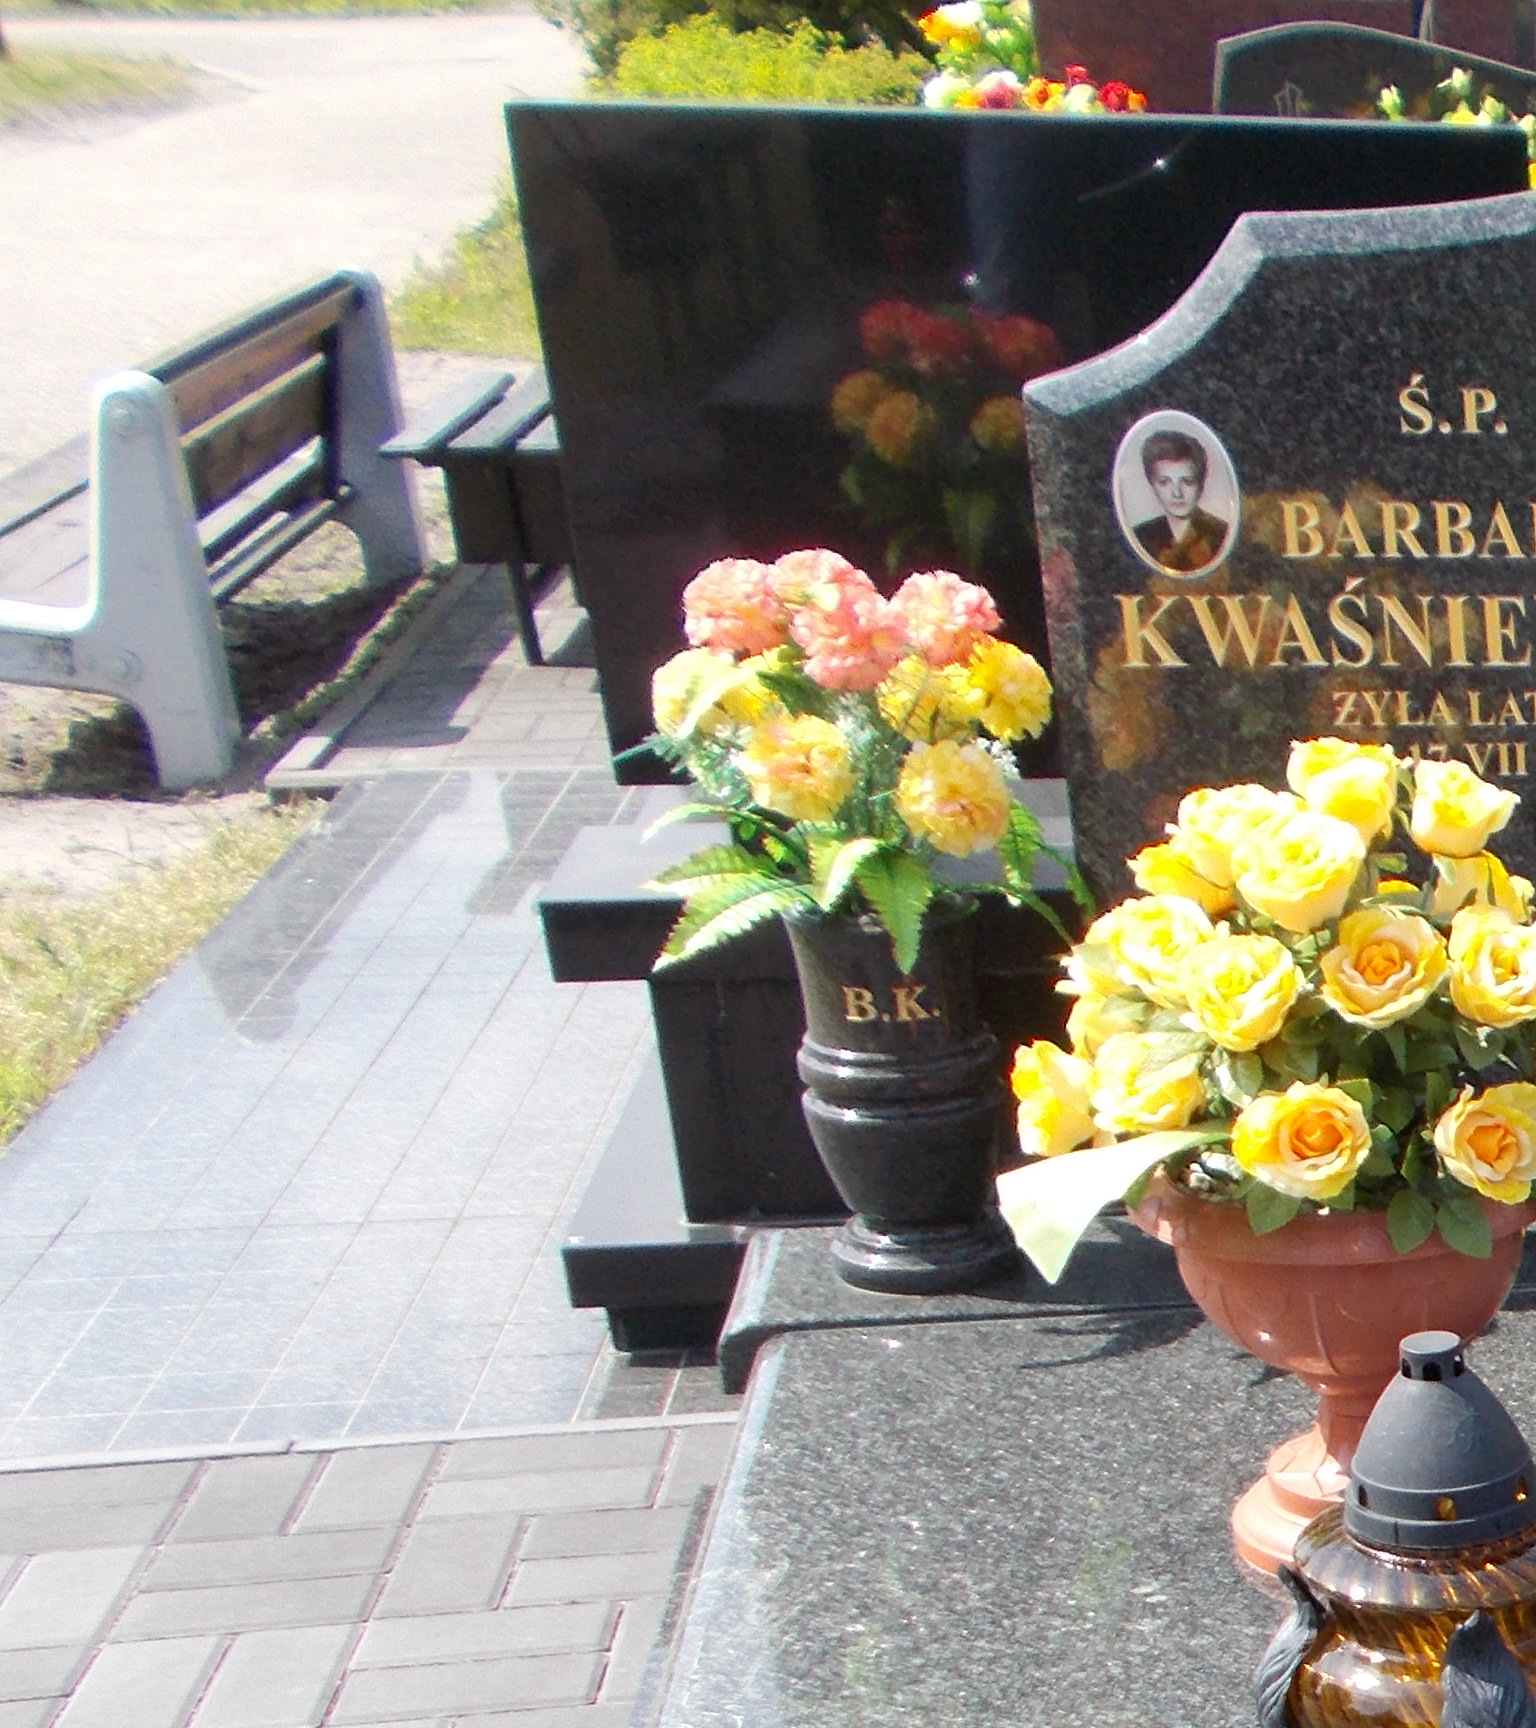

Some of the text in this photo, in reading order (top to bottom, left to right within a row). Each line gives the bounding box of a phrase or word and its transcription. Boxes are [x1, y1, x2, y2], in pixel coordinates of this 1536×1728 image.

[1398, 372, 1509, 435] Ś.P.
[1461, 740, 1529, 776] VII
[842, 984, 942, 1023] B.K.
